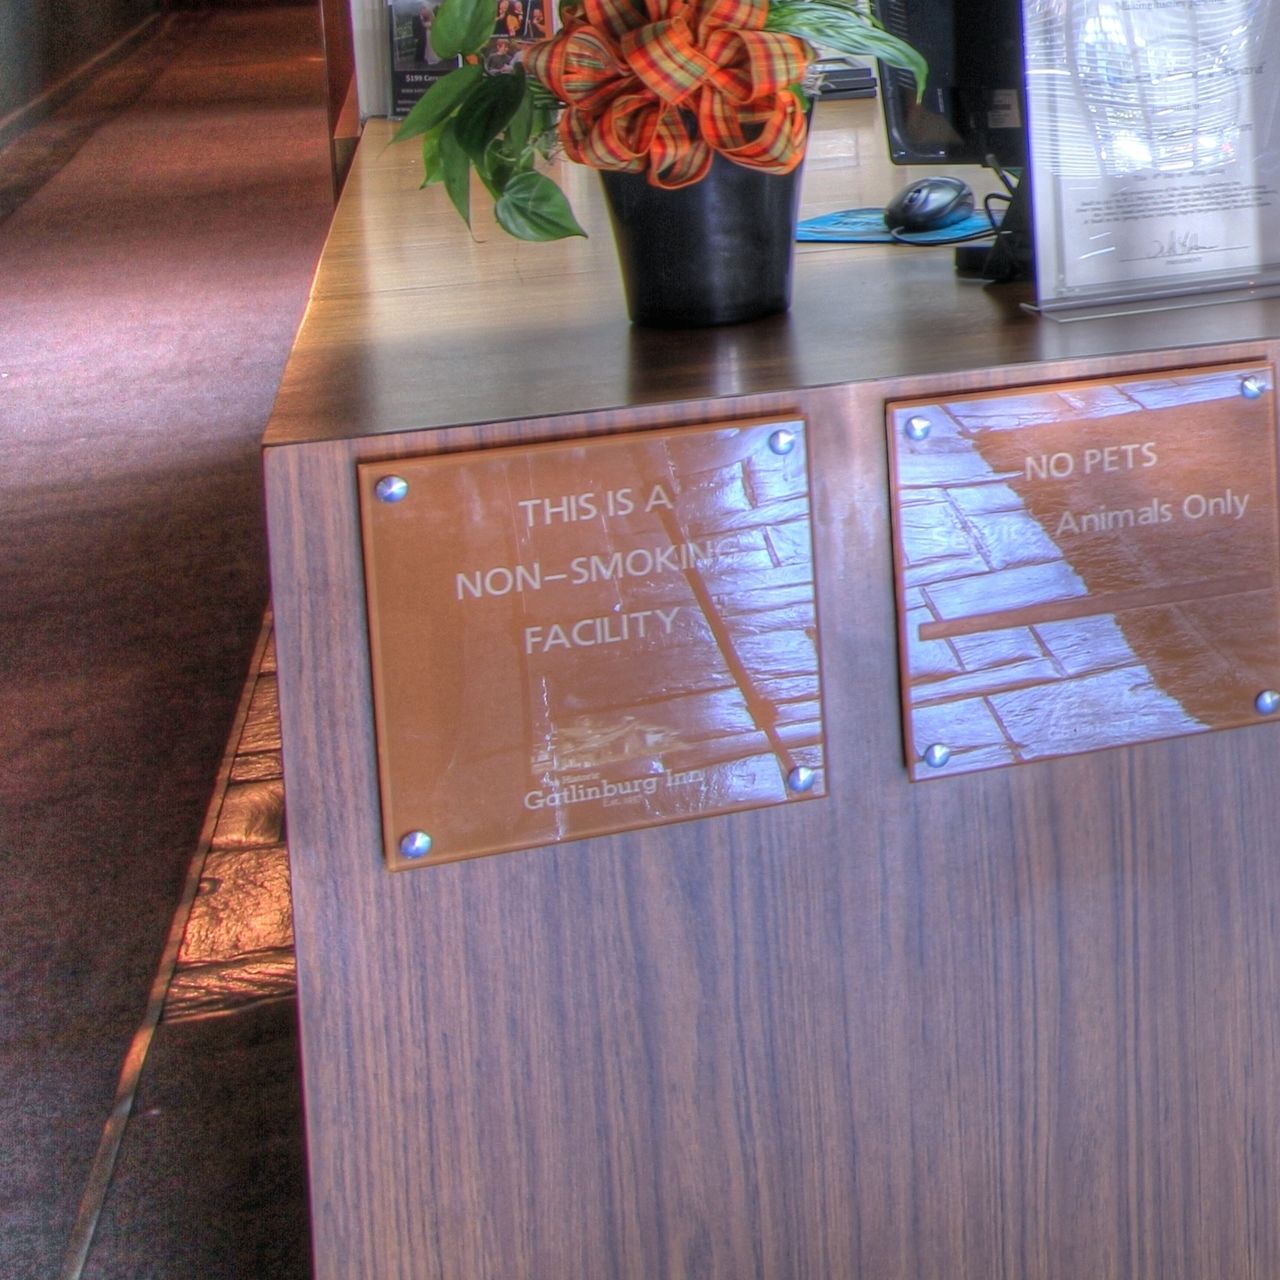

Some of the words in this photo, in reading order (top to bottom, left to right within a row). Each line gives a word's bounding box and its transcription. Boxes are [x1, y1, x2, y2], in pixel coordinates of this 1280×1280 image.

[1024, 451, 1075, 482] NO
[1084, 442, 1158, 475] PETS
[518, 492, 598, 528] THIS
[606, 487, 635, 517] IS
[644, 484, 674, 513] A
[1055, 497, 1173, 538] Animals
[1182, 488, 1250, 521] Only
[524, 606, 682, 655] FACILITY
[524, 776, 659, 811] Gatlinburg
[665, 768, 707, 788] Inn
